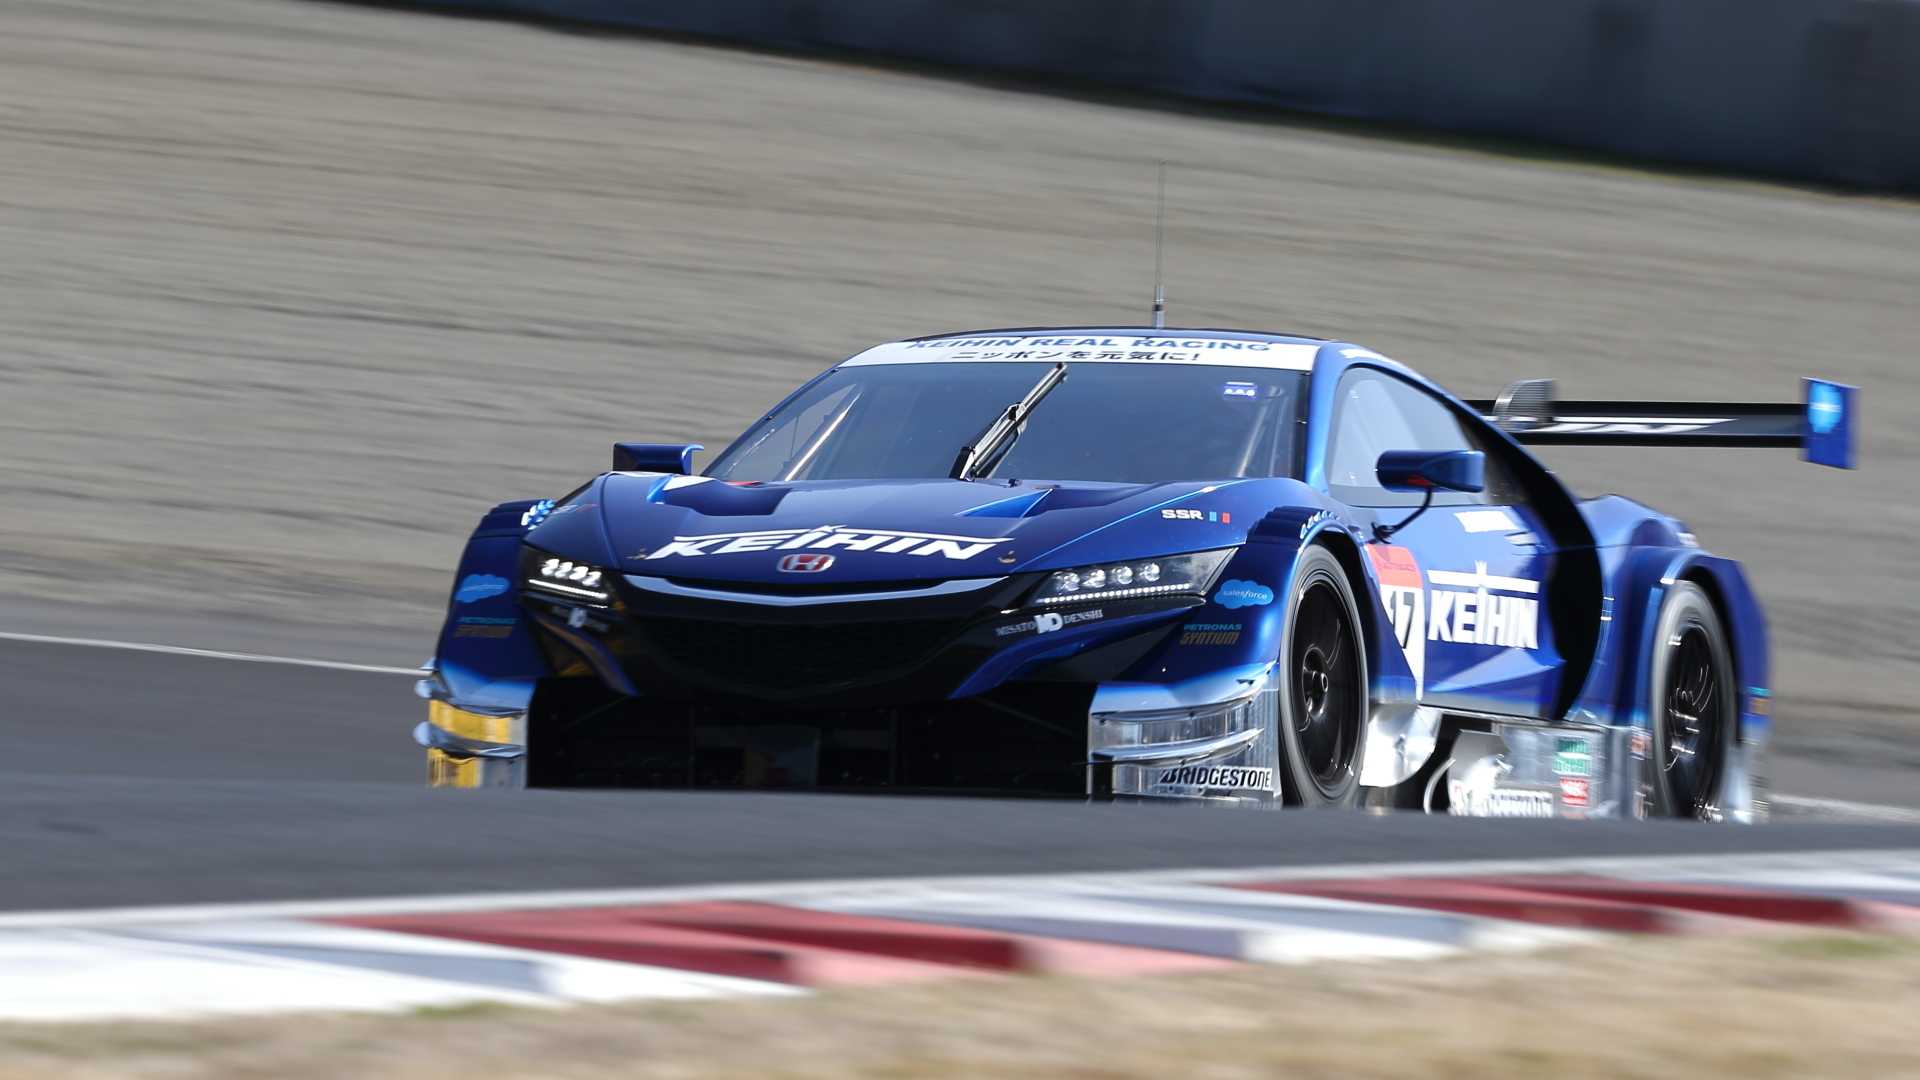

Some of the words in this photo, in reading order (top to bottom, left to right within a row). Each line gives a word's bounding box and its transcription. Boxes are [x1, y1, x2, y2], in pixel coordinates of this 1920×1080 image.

[1029, 338, 1119, 347] REAL
[1131, 338, 1271, 351] RACING
[1161, 509, 1204, 520] SSR
[645, 530, 1005, 560] KEIHIN
[1223, 589, 1268, 600] salesforce
[1063, 609, 1104, 624] DENSHI
[1390, 590, 1415, 649] 17
[1427, 580, 1539, 649] KEIHIN
[1183, 623, 1242, 631] PETRONAS
[1179, 631, 1240, 645] SYNTIUM
[1159, 766, 1272, 788] BRIDGESTONE
